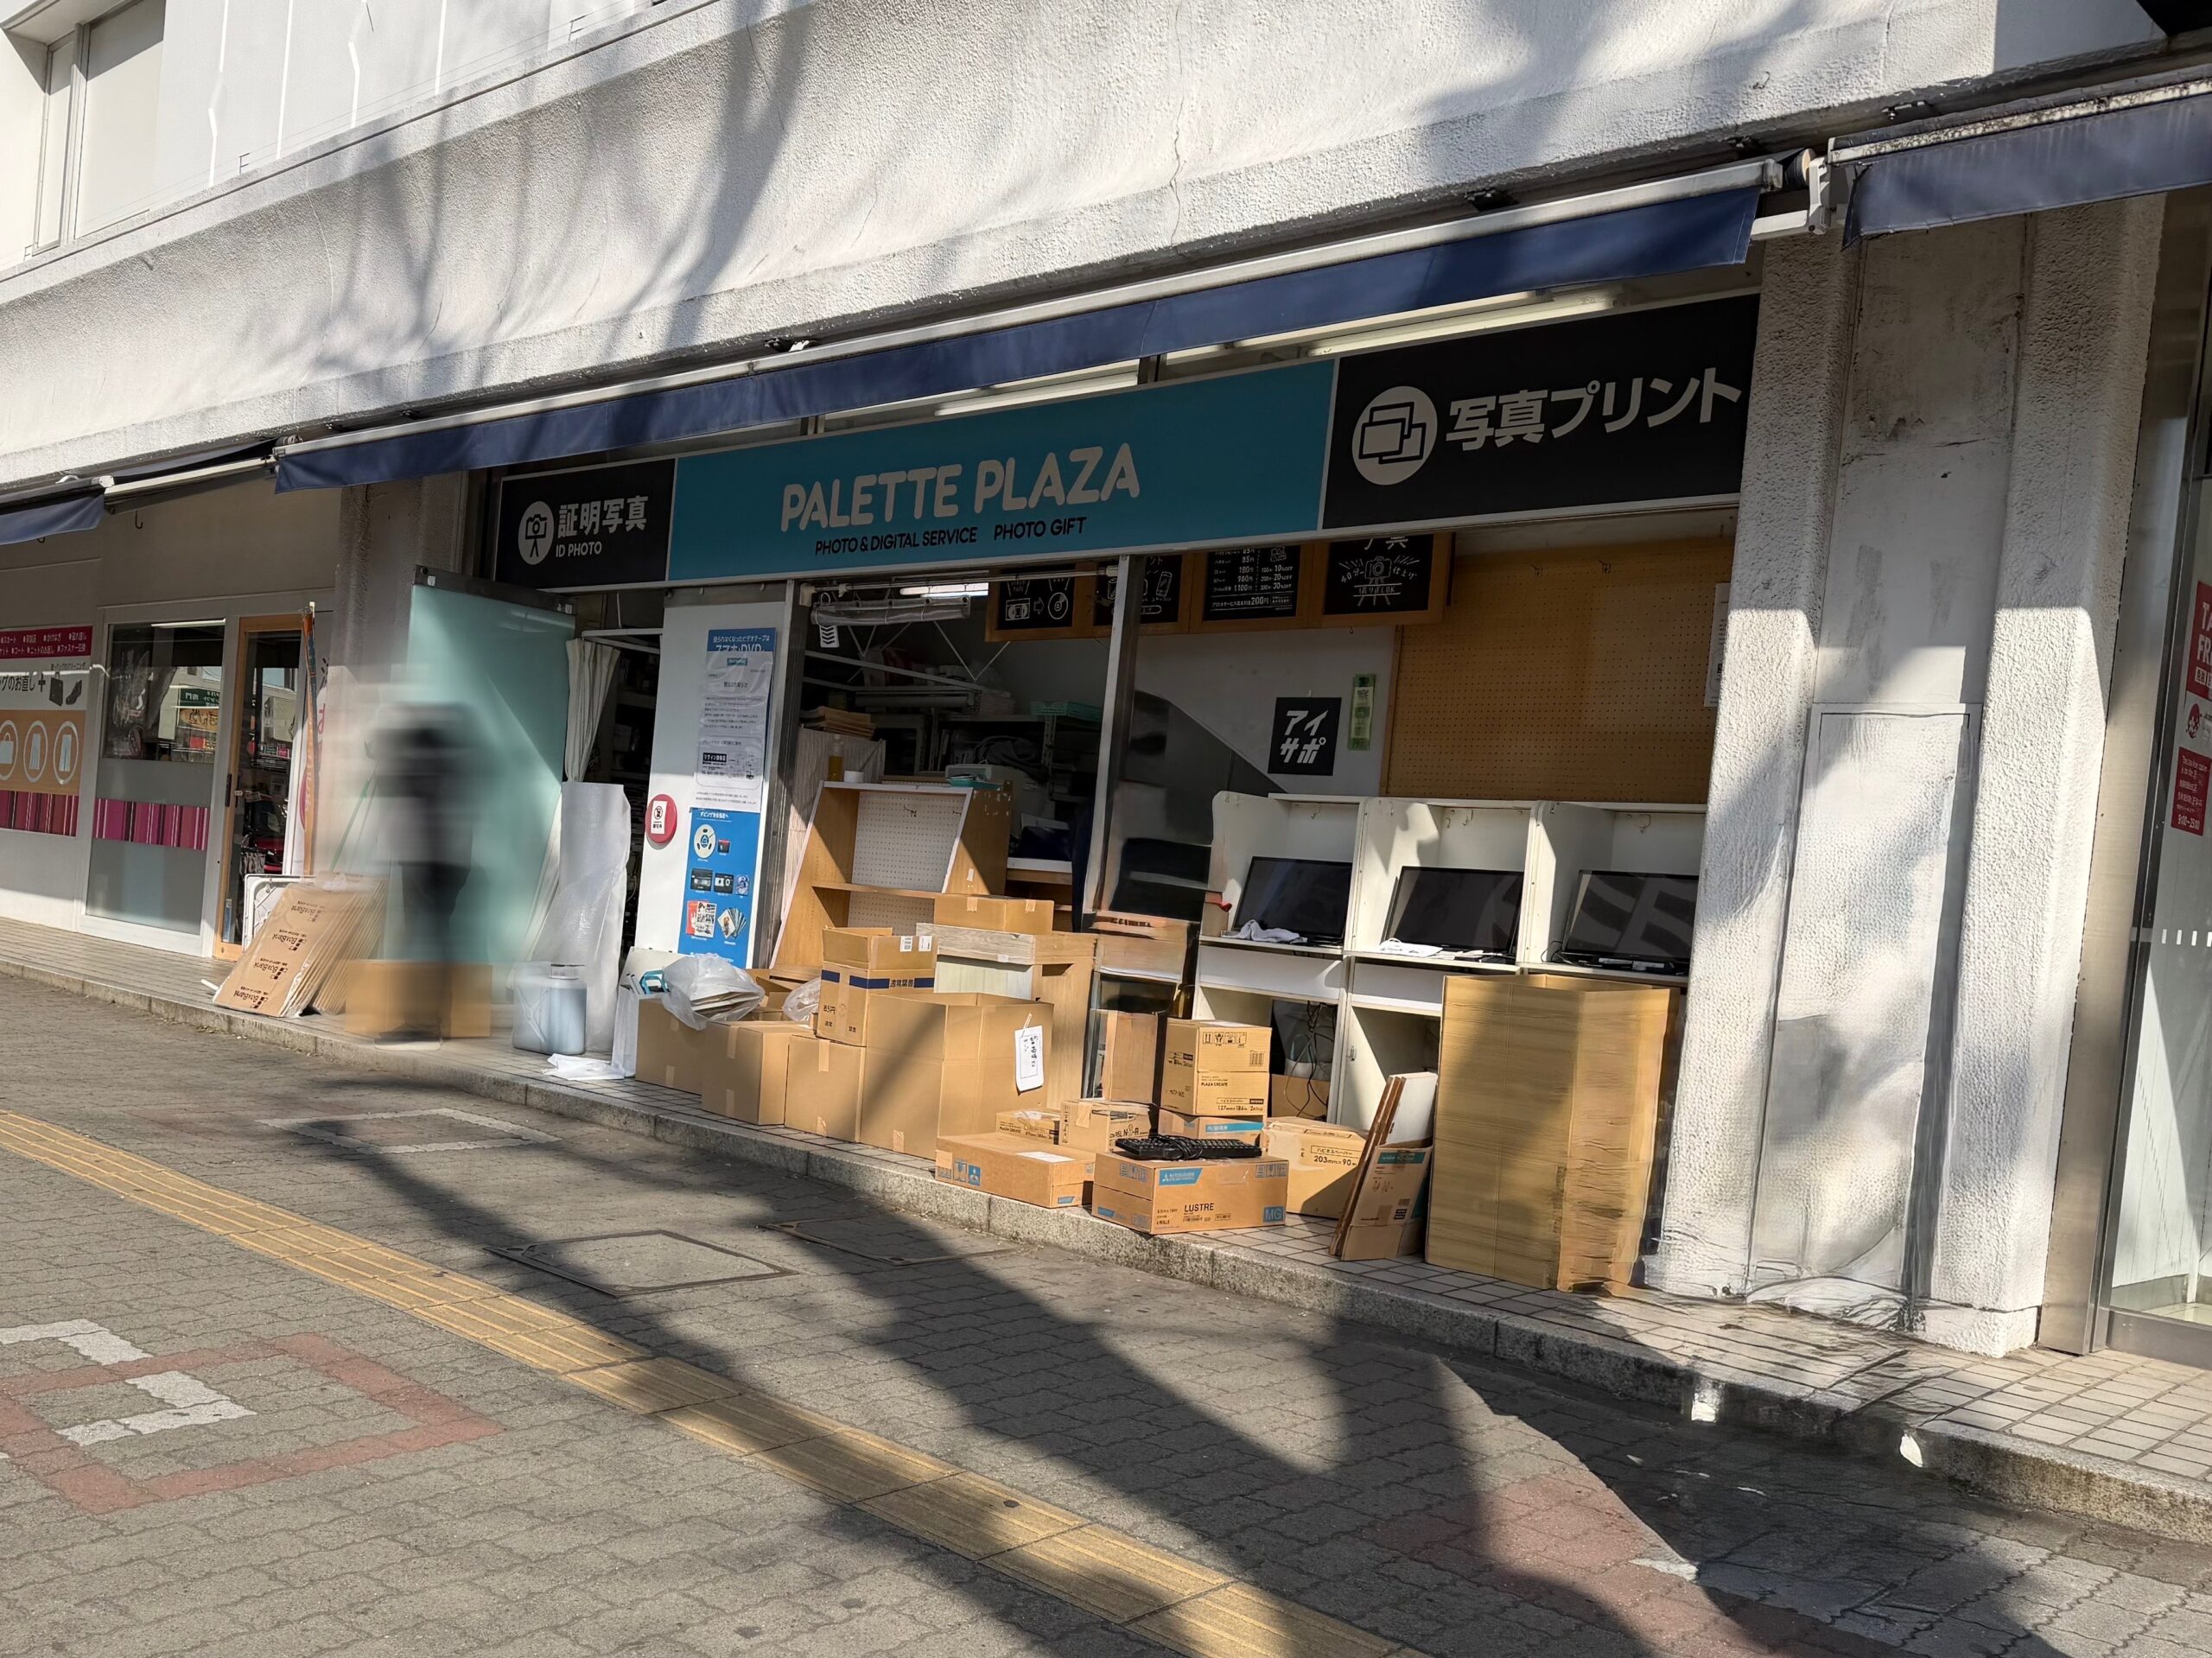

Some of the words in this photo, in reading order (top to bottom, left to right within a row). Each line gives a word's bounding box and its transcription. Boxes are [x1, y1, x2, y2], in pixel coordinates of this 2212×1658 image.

[1446, 367, 1742, 451] 写真プリント
[780, 464, 963, 531] PALETTE
[975, 442, 1141, 513] PLAZA
[557, 495, 649, 538] 証明写真
[556, 544, 566, 557] ID
[568, 541, 602, 557] PHOTO
[816, 540, 858, 556] PHOTO
[860, 537, 869, 551] &
[870, 531, 920, 550] DIGITAL
[923, 526, 978, 546] SERVICE
[994, 520, 1047, 541] PHOTO
[1051, 516, 1088, 536] GIFT
[1284, 709, 1329, 736] アイ
[1280, 737, 1326, 764] サポ
[1184, 1203, 1215, 1212] LUSTRE
[1265, 1208, 1282, 1222] MG
